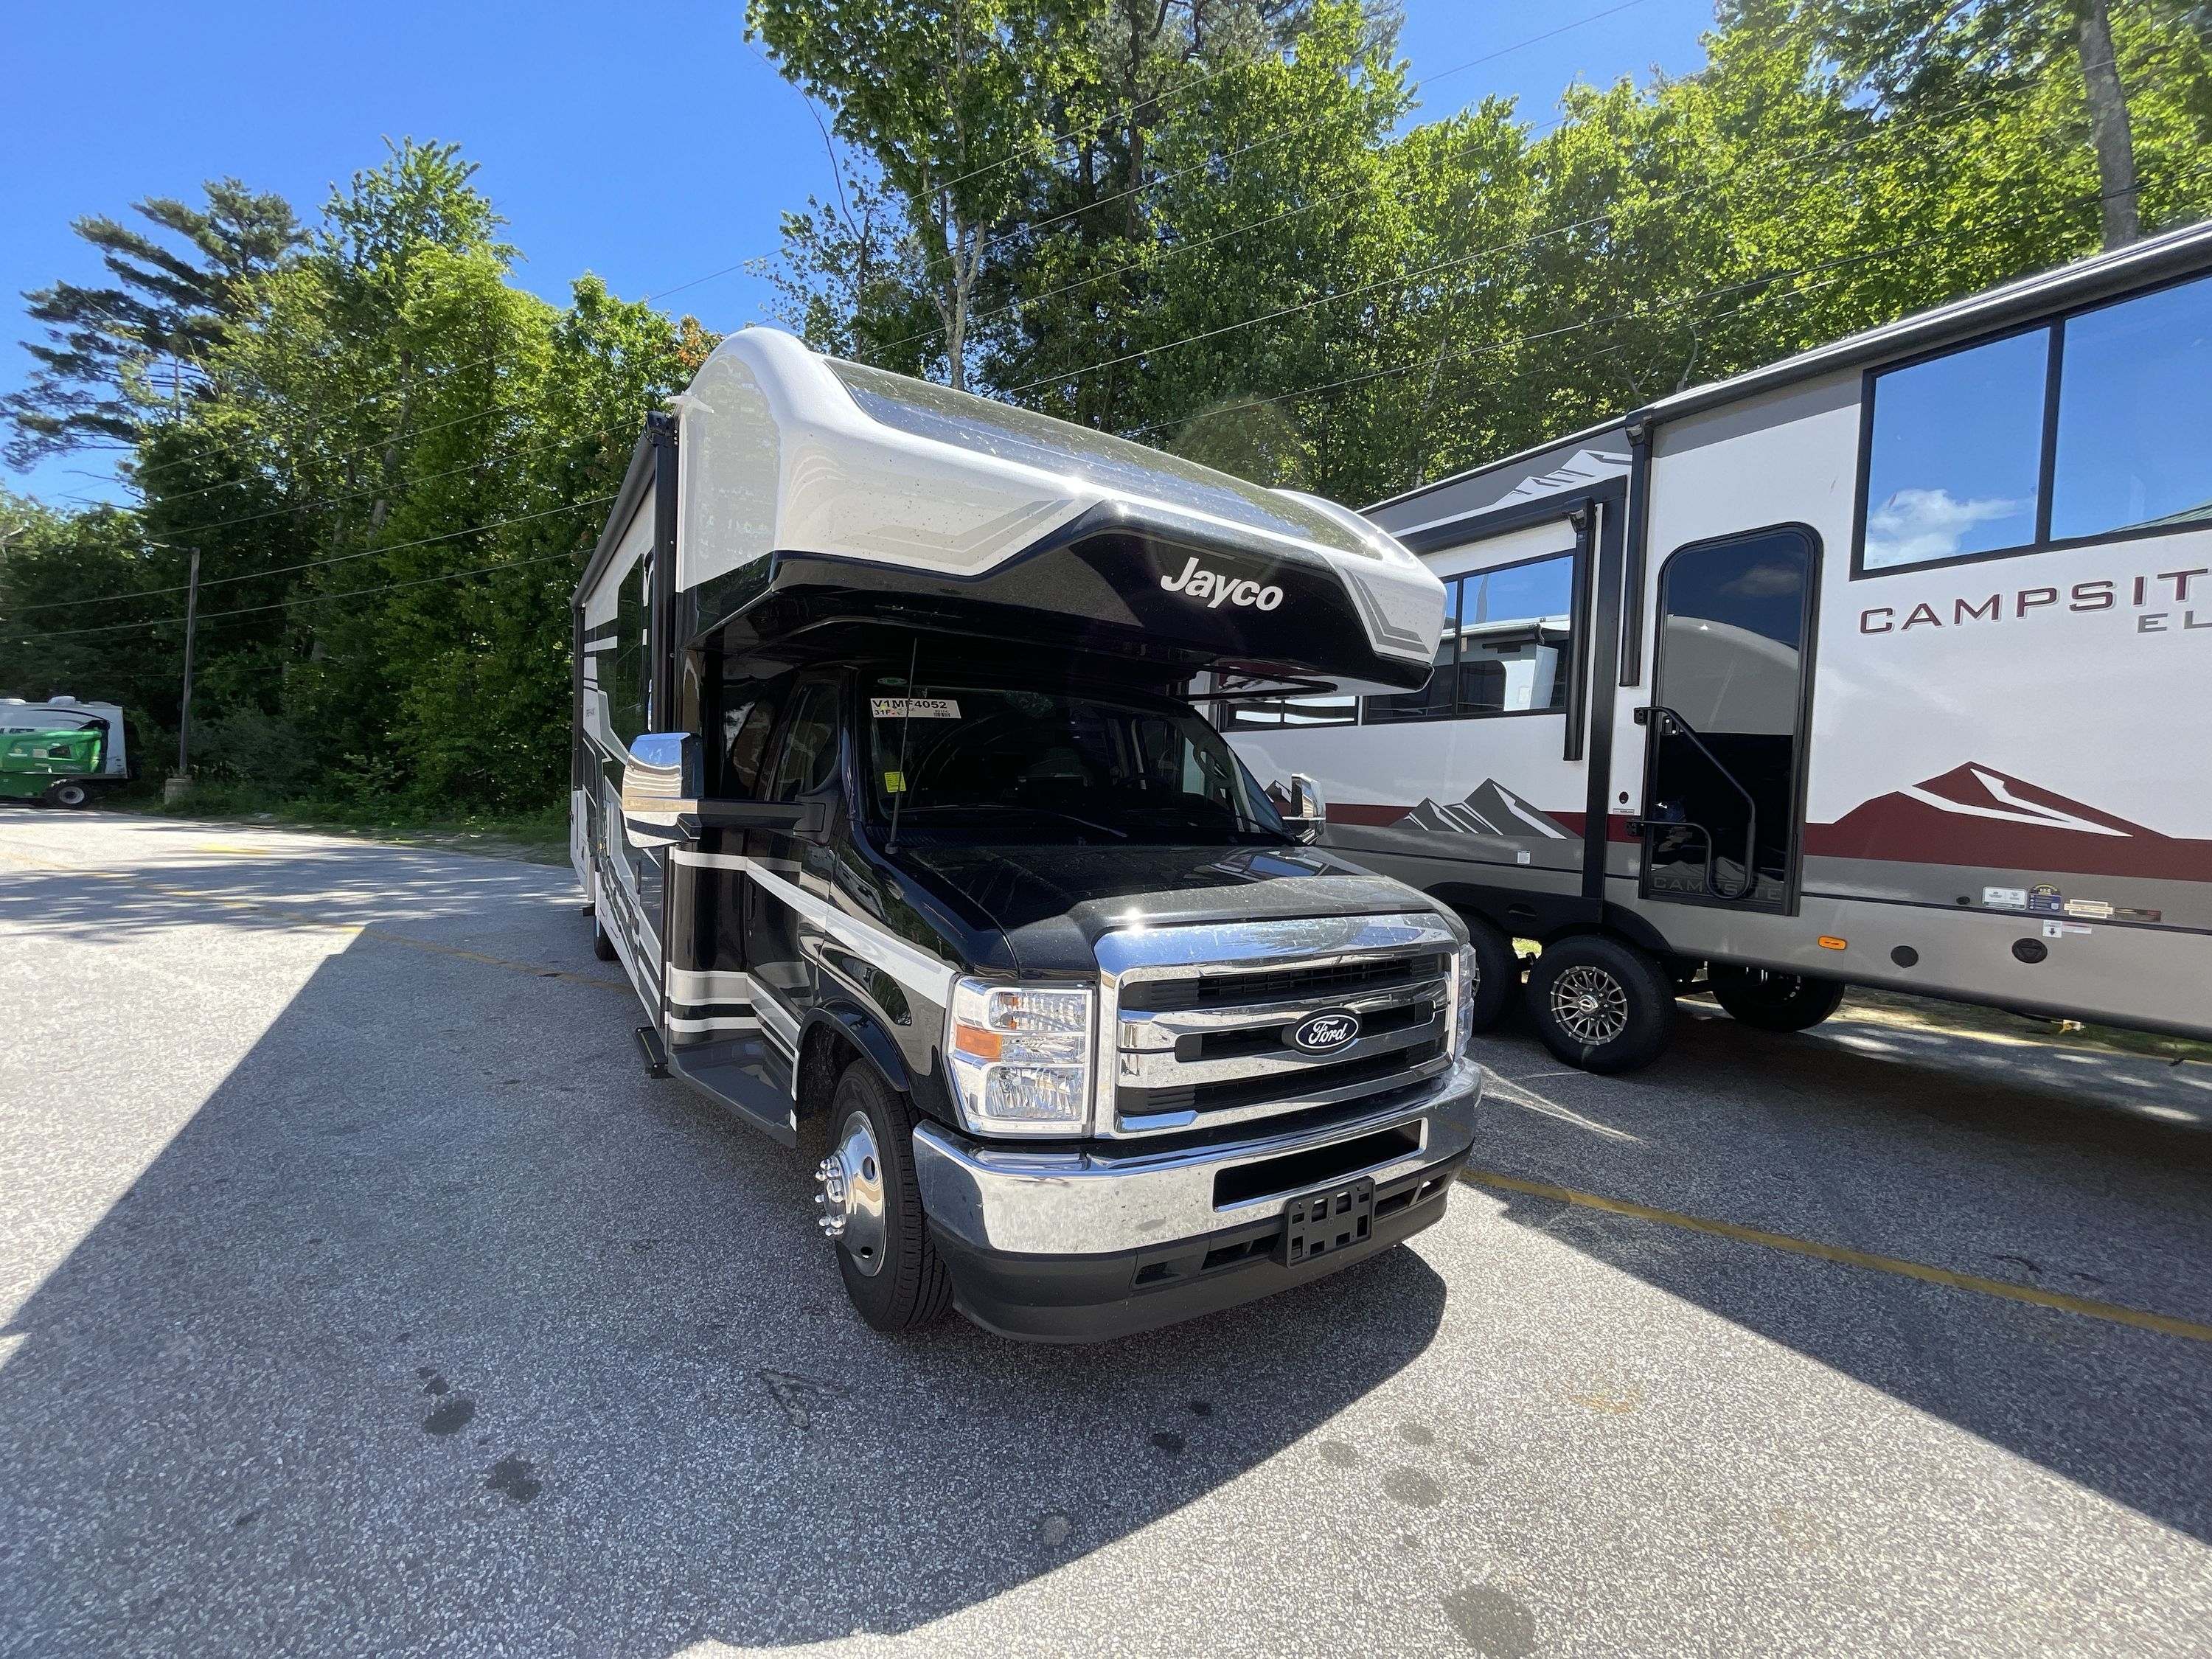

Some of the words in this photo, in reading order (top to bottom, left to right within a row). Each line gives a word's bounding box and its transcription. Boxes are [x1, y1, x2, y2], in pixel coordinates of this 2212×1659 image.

[1161, 557, 1284, 611] Jayco
[1860, 568, 2209, 634] CAMPSIT
[1308, 1020, 1348, 1044] Ford
